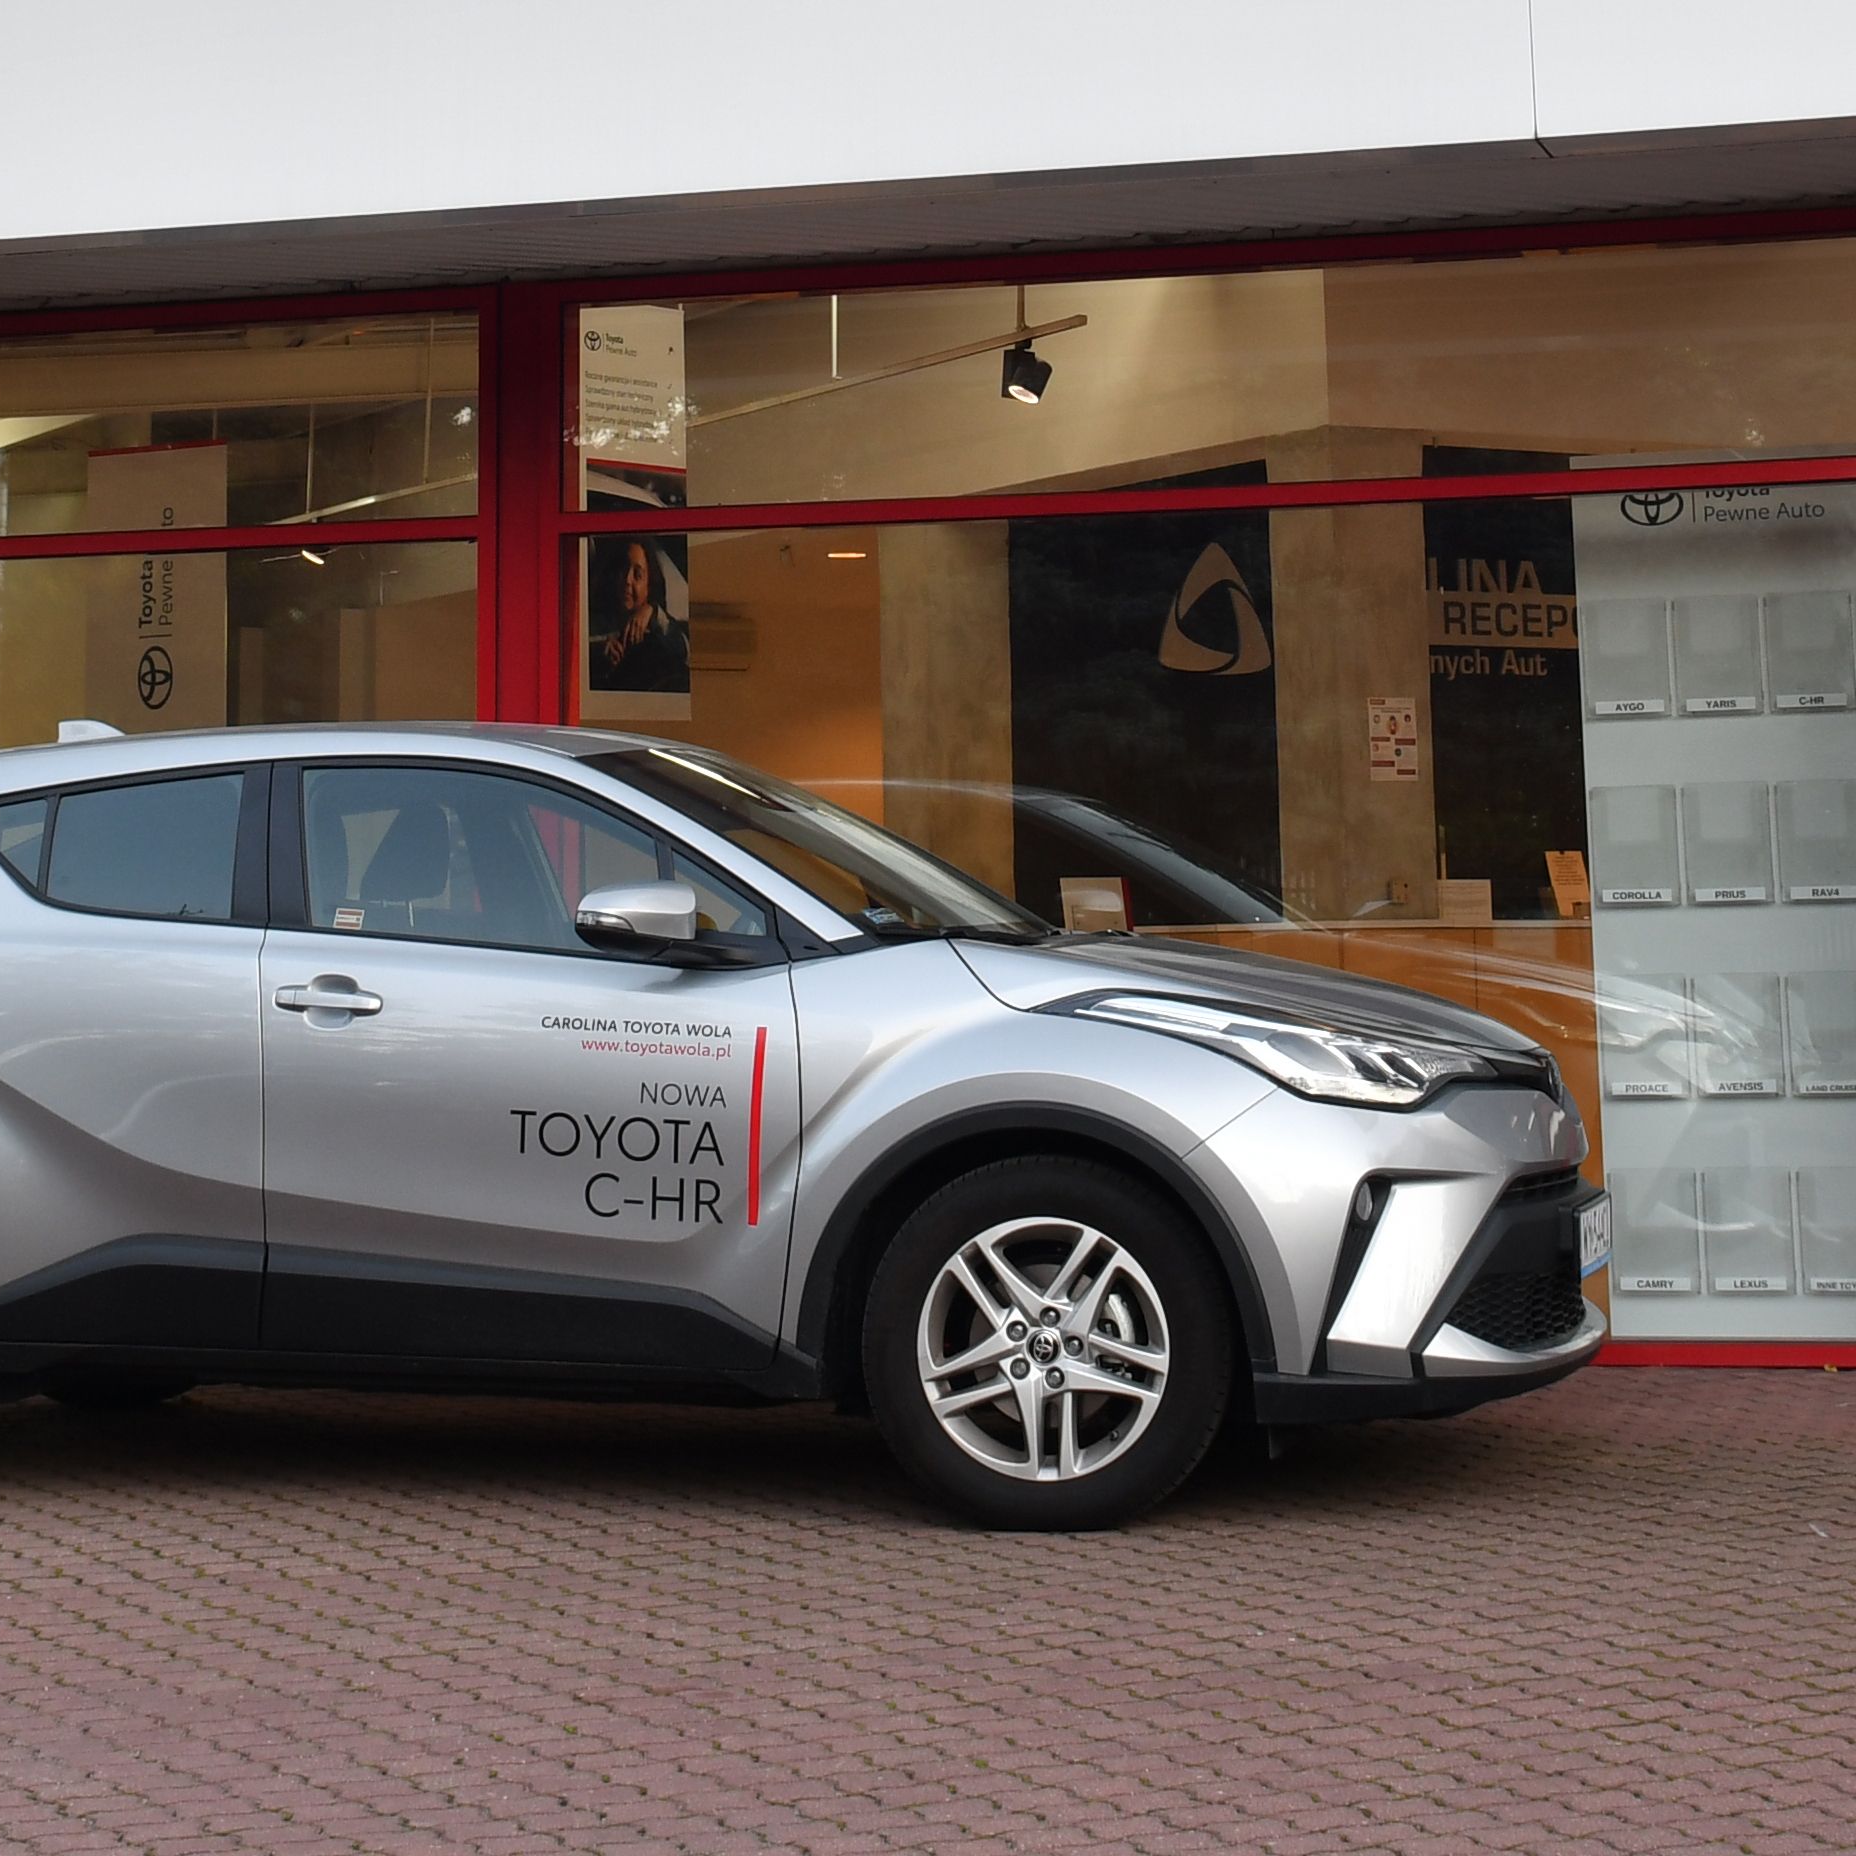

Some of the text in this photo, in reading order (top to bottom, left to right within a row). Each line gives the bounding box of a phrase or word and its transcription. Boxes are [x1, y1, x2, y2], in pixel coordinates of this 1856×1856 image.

[1703, 501, 1825, 522] Pewne Auto
[138, 559, 156, 628] Toyota
[159, 559, 174, 626] Pewne
[1705, 700, 1737, 709] YARIS
[1799, 696, 1824, 705] C-HR
[1615, 702, 1645, 711] AYGO
[1612, 891, 1662, 900] COROLLA
[1715, 890, 1746, 899] PRIUS
[1811, 888, 1840, 897] RAV4
[541, 1016, 732, 1039] CAROLINA TOYOTA WOLA
[581, 1038, 732, 1061] www.toyotawola.pl
[1625, 1084, 1669, 1092] PROACE
[1718, 1082, 1764, 1091] AVENSIS
[640, 1082, 727, 1109] NOWA
[510, 1109, 725, 1167] TOYOTA
[584, 1172, 723, 1225] C-HR
[1636, 1279, 1675, 1289] CAMRY
[1733, 1279, 1769, 1288] LEXUS
